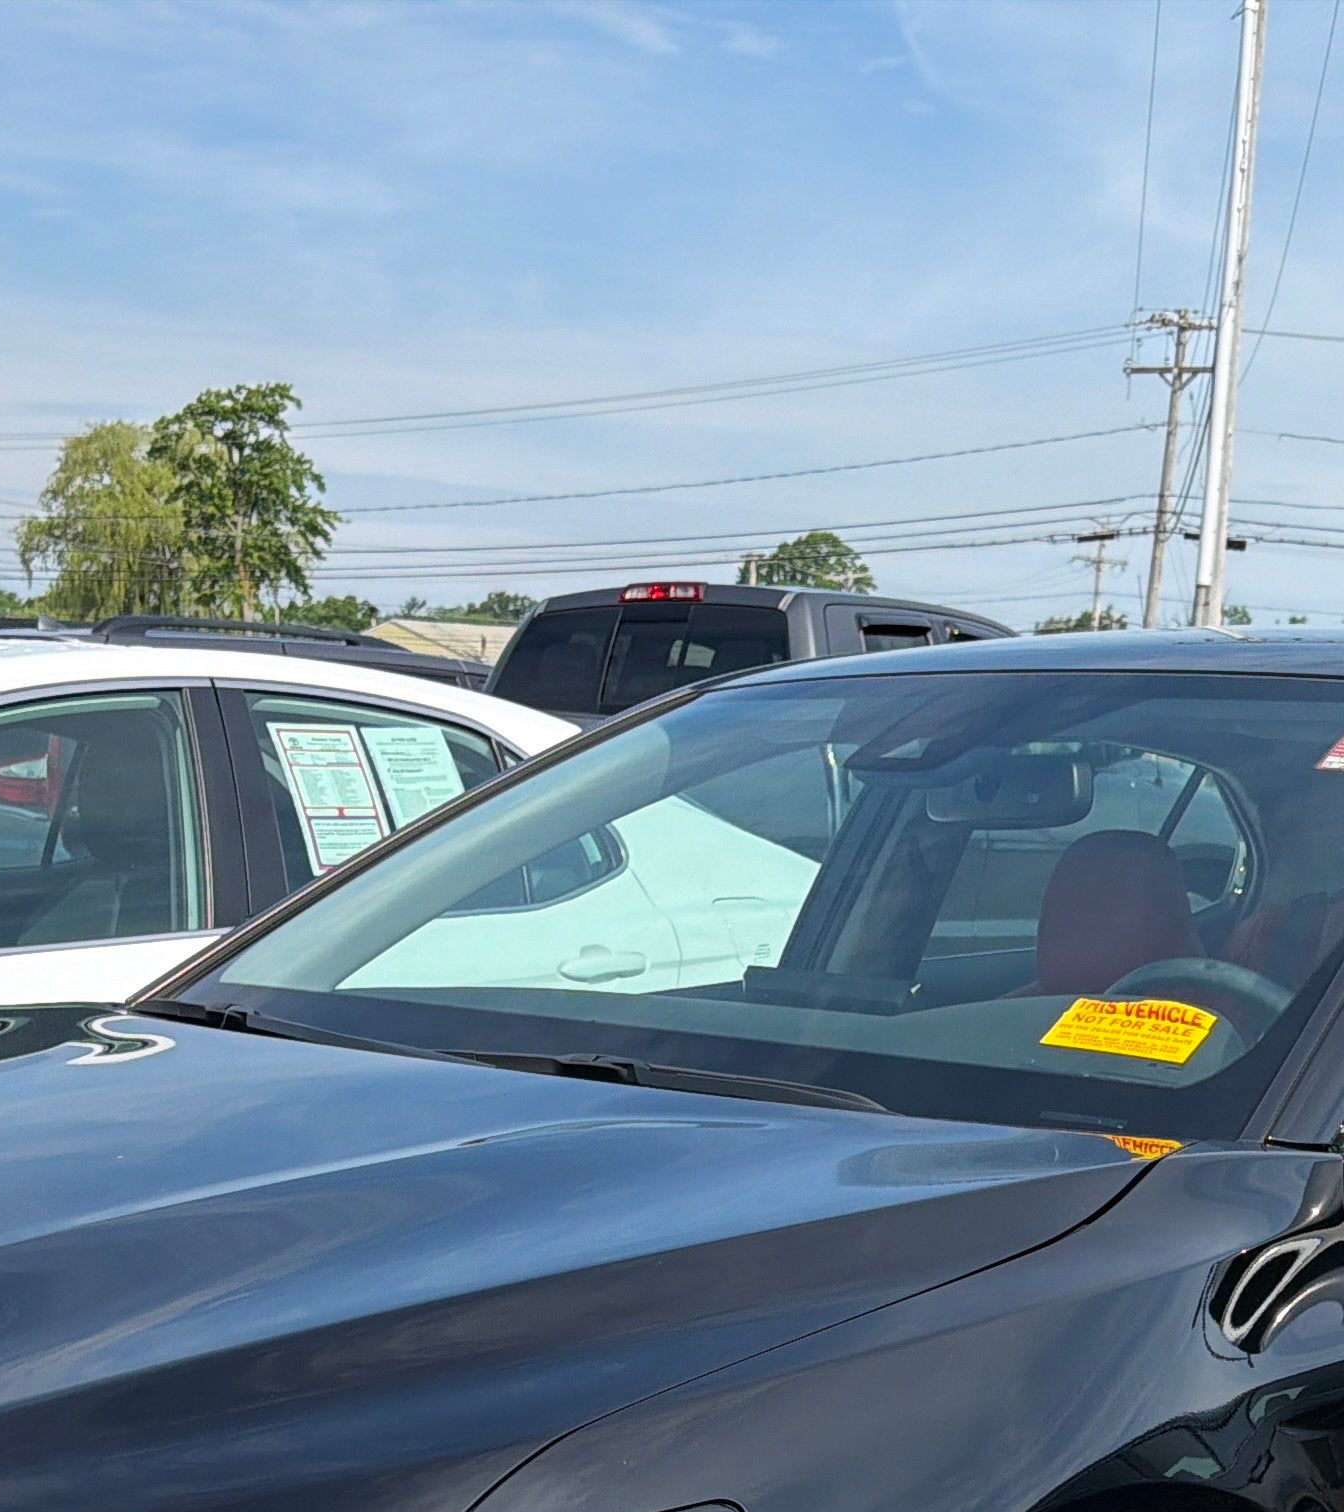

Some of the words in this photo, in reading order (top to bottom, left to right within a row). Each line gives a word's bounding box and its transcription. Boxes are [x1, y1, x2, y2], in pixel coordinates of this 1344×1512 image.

[1071, 1013, 1107, 1025] NOT
[1109, 1018, 1146, 1031] FOR
[1149, 1023, 1195, 1037] SALE
[1078, 1000, 1118, 1015] THIS
[1124, 1001, 1207, 1027] VEHICLE
